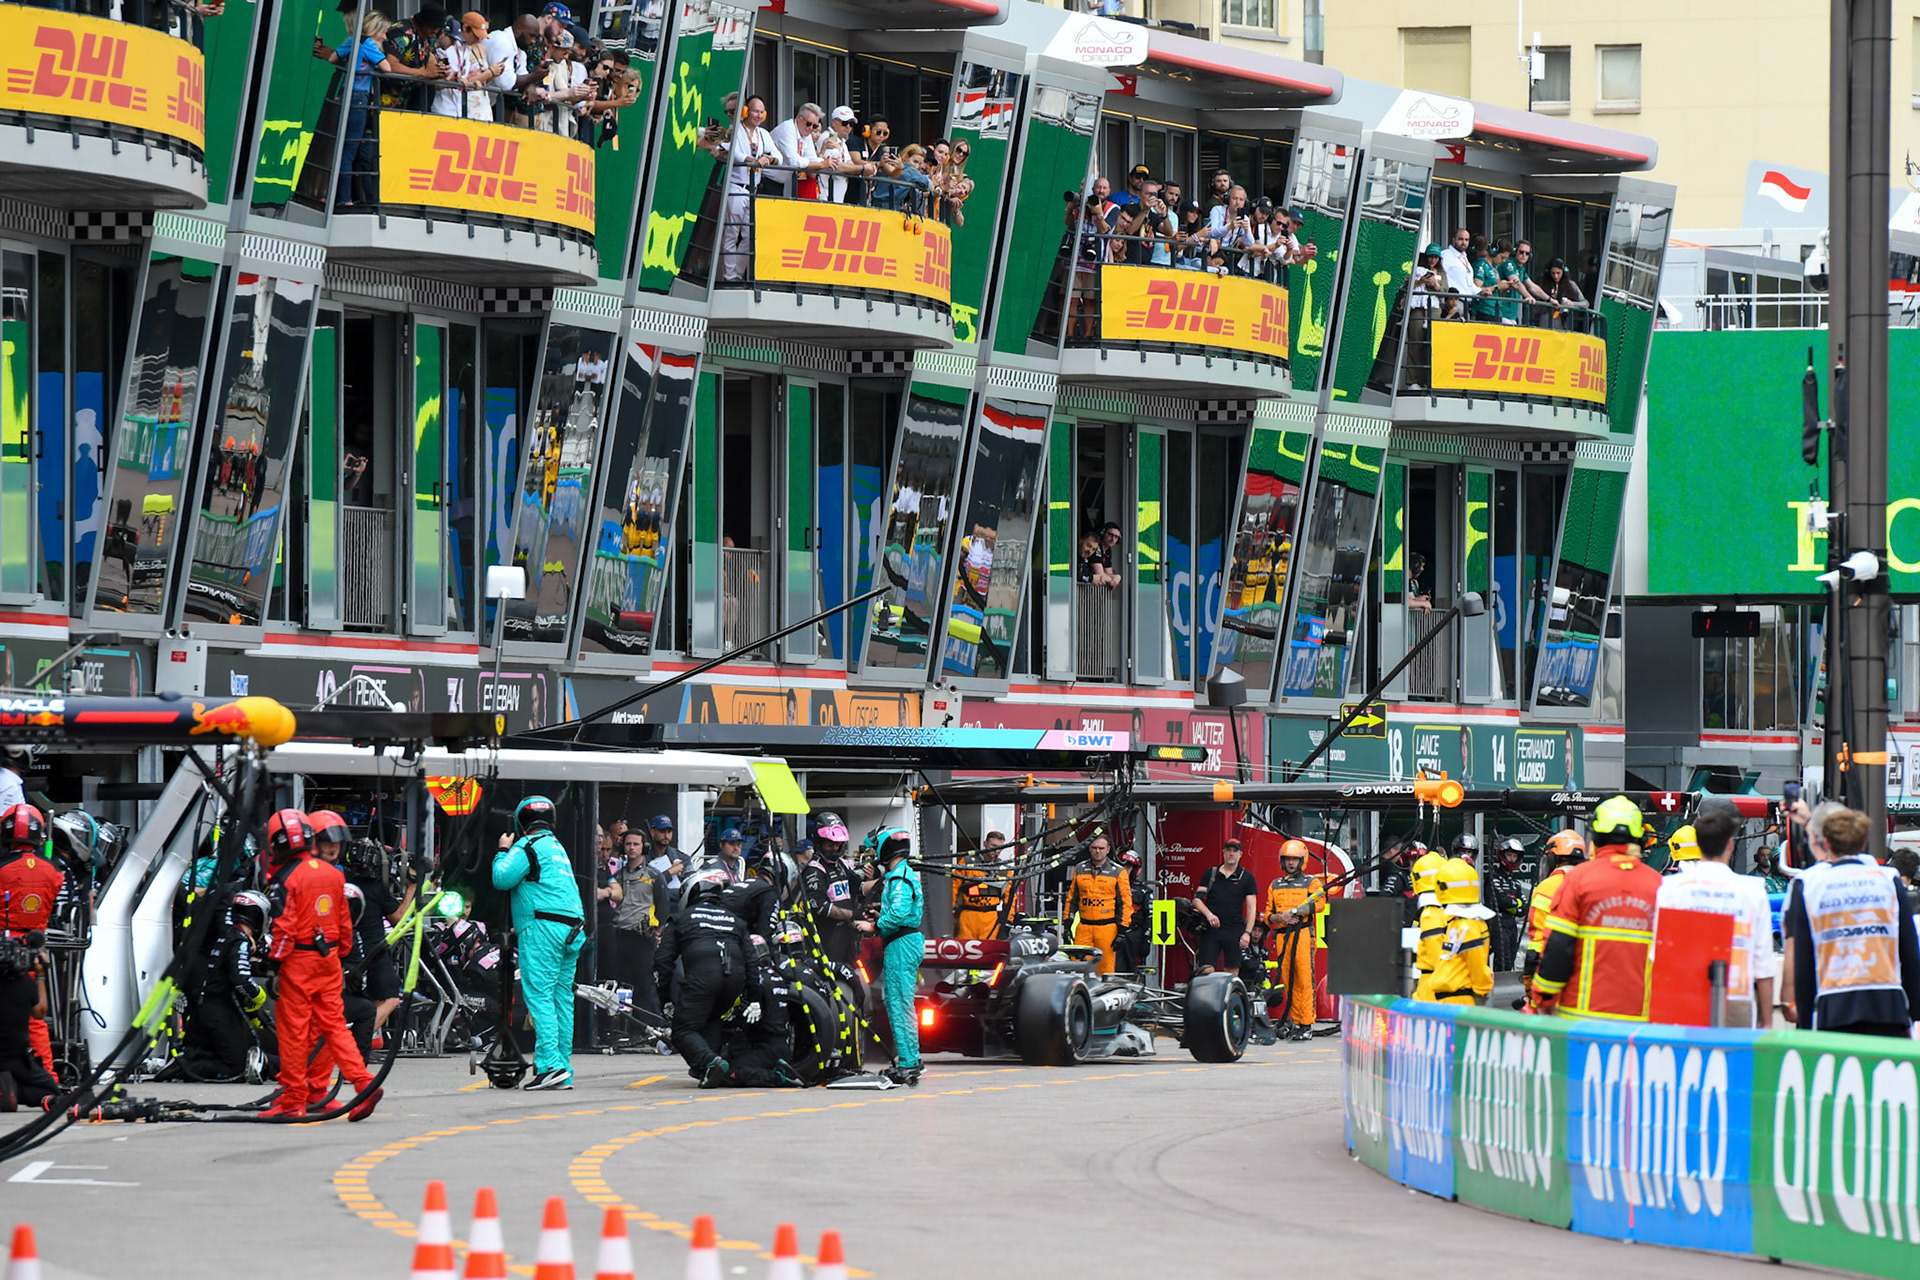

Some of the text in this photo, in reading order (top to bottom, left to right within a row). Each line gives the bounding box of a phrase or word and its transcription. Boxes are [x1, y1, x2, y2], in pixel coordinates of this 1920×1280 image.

[1075, 46, 1133, 54] MONACO
[1081, 54, 1126, 63] CIRCUIT
[32, 26, 133, 109] DHL
[1406, 120, 1460, 128] MONACO
[1412, 127, 1453, 136] CIRCUIT
[431, 130, 523, 202] DHL
[801, 215, 886, 276] DHL
[1145, 280, 1224, 335] DHL
[1471, 334, 1545, 384] DHL
[82, 661, 104, 693] ORGE
[355, 678, 387, 707] PIERRE
[483, 683, 520, 712] ESEBAN
[0, 699, 65, 712] RACLE
[737, 702, 766, 724] LANDO
[854, 706, 878, 727] OSCAR
[611, 710, 645, 724] McLaren
[1078, 735, 1113, 747] BWT
[1192, 721, 1225, 746] VALTTERI
[1387, 728, 1403, 782] 18
[1415, 734, 1439, 756] LANCE
[1516, 738, 1555, 761] FERNANDO
[1492, 734, 1506, 782] 14
[1517, 761, 1546, 783] ALONSO
[1355, 784, 1414, 795] DP WORLD
[1550, 791, 1601, 806] Alfa Romeo
[1886, 801, 1920, 811] ogniza
[1158, 868, 1191, 886] Stake
[1601, 914, 1648, 930] MONACO
[923, 939, 983, 960] EOS
[1017, 937, 1050, 956] INEOS
[1460, 1025, 1553, 1192] aramco
[1582, 1041, 1728, 1218] aramco
[1773, 1048, 1920, 1244] aram
